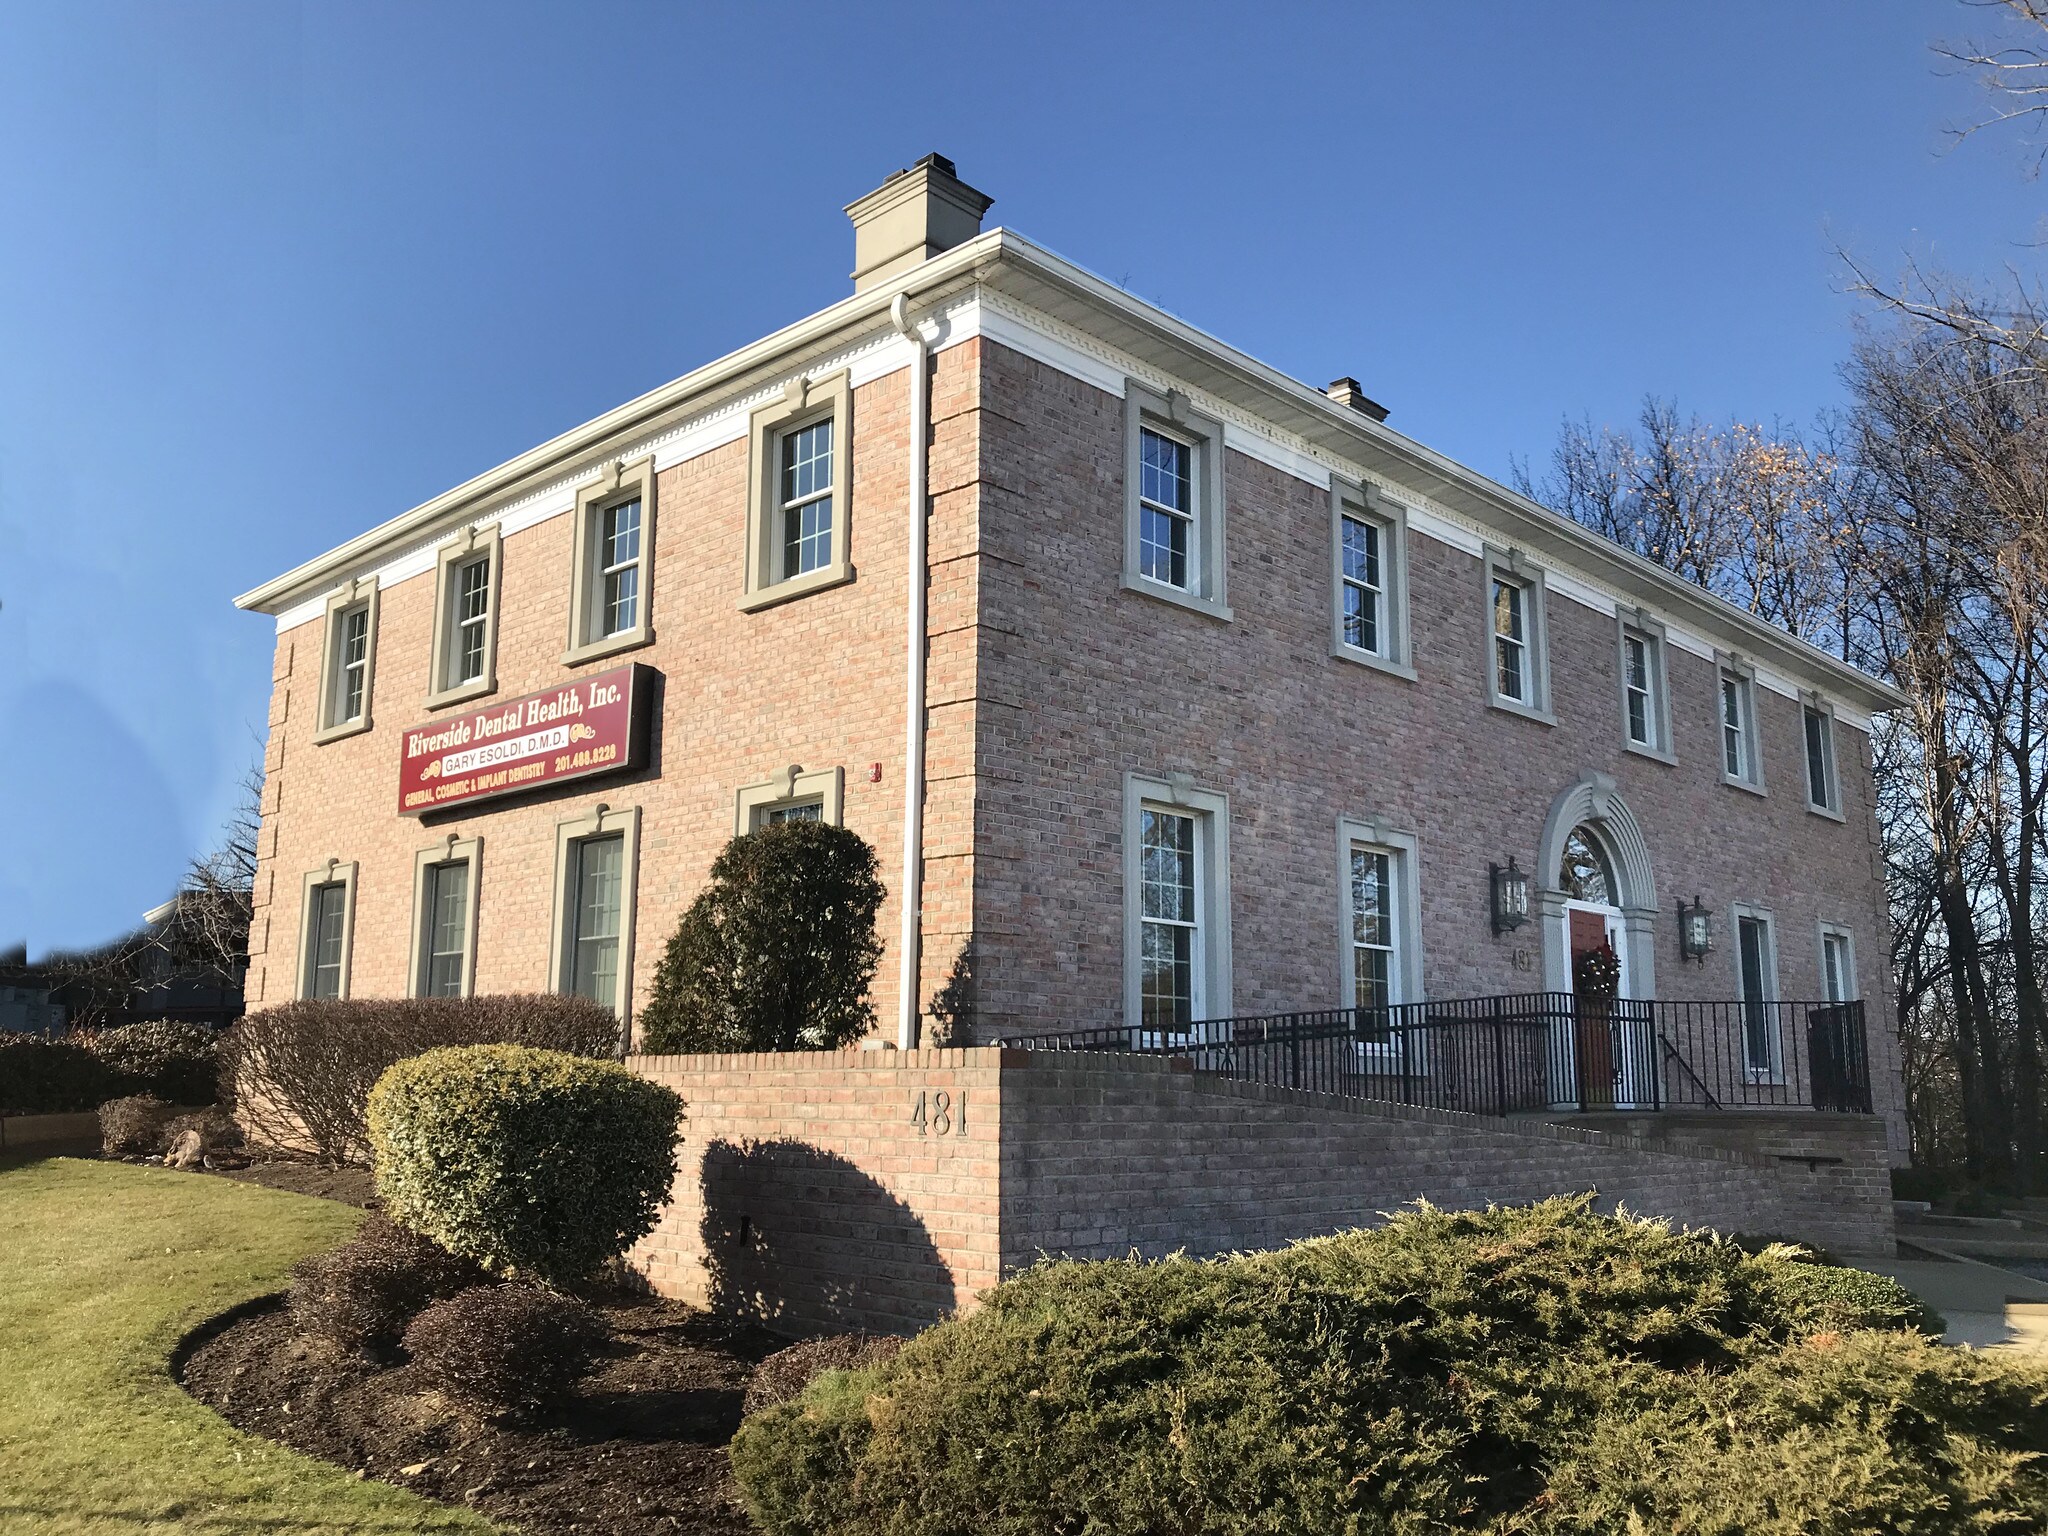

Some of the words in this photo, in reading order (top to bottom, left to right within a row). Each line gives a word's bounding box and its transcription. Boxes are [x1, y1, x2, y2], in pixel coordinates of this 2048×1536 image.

[407, 723, 471, 758] Riverside
[474, 703, 523, 741] Dental
[526, 689, 583, 725] Health,
[588, 682, 621, 710] Inc.
[445, 754, 476, 773] GARY
[479, 742, 525, 763] ESOLDI,
[527, 732, 565, 750] D.M.D.
[405, 788, 435, 808] GENERAL,
[435, 779, 470, 800] COSMETIC
[470, 778, 477, 792] &
[477, 770, 508, 790] IMPLANT
[508, 761, 546, 784] DENTISTRY
[1511, 948, 1531, 972] 481
[910, 1090, 967, 1137] 481
